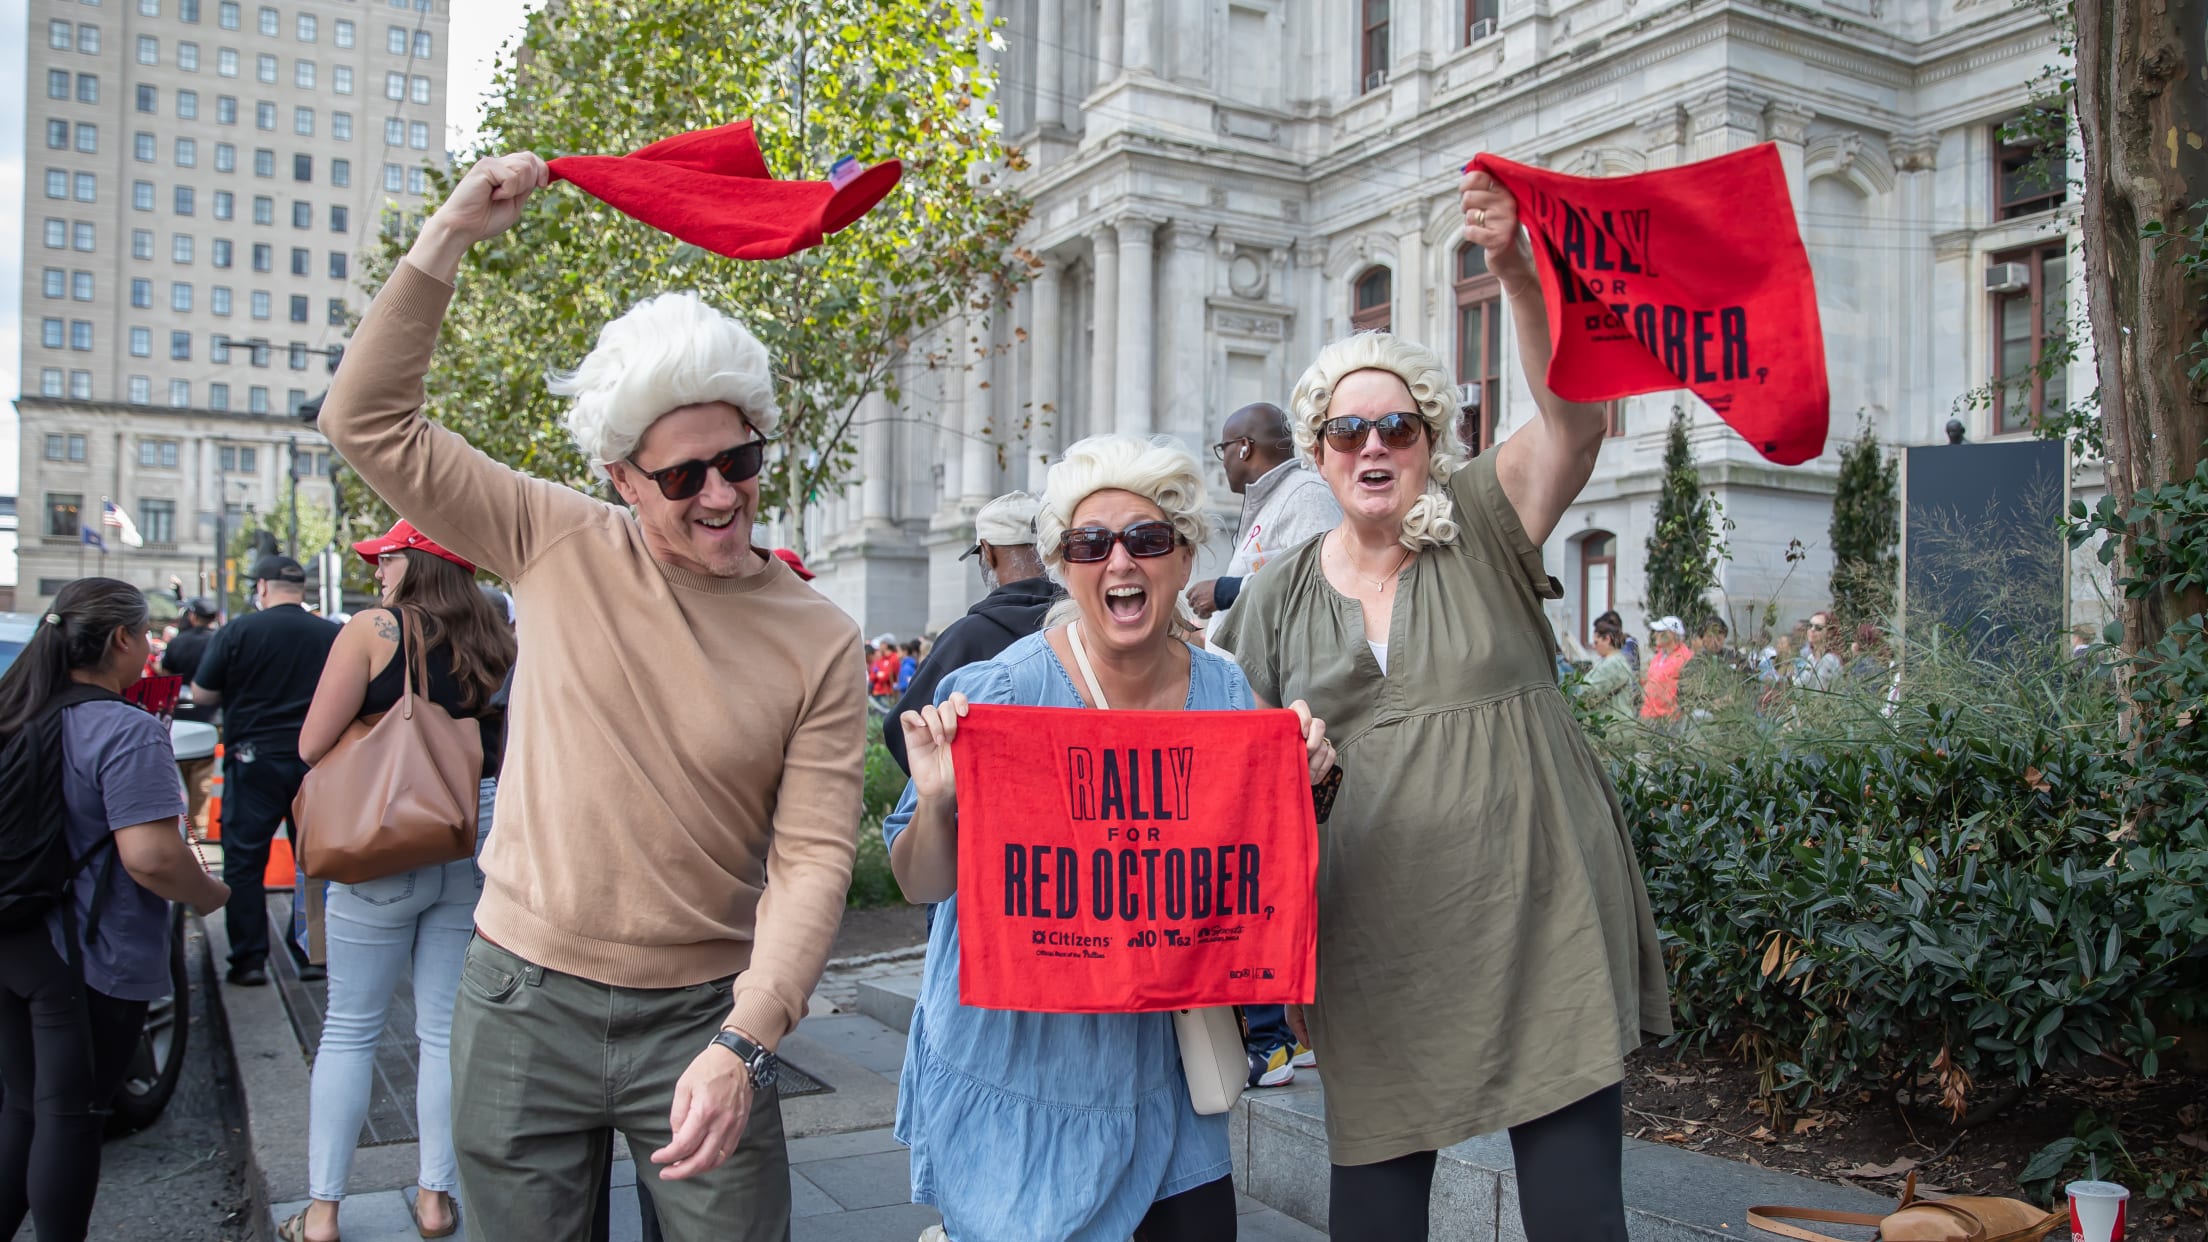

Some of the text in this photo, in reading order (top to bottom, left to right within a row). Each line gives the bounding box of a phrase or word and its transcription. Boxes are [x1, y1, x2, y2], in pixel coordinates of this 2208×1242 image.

[1530, 184, 1659, 278] RALLY
[1589, 278, 1627, 296] OR
[1609, 304, 1750, 384] TOBER
[1068, 747, 1193, 821] RALLY
[1107, 827, 1161, 842] FOR
[1004, 843, 1260, 922] RED OCTOBER
[1049, 931, 1110, 948] Citizens
